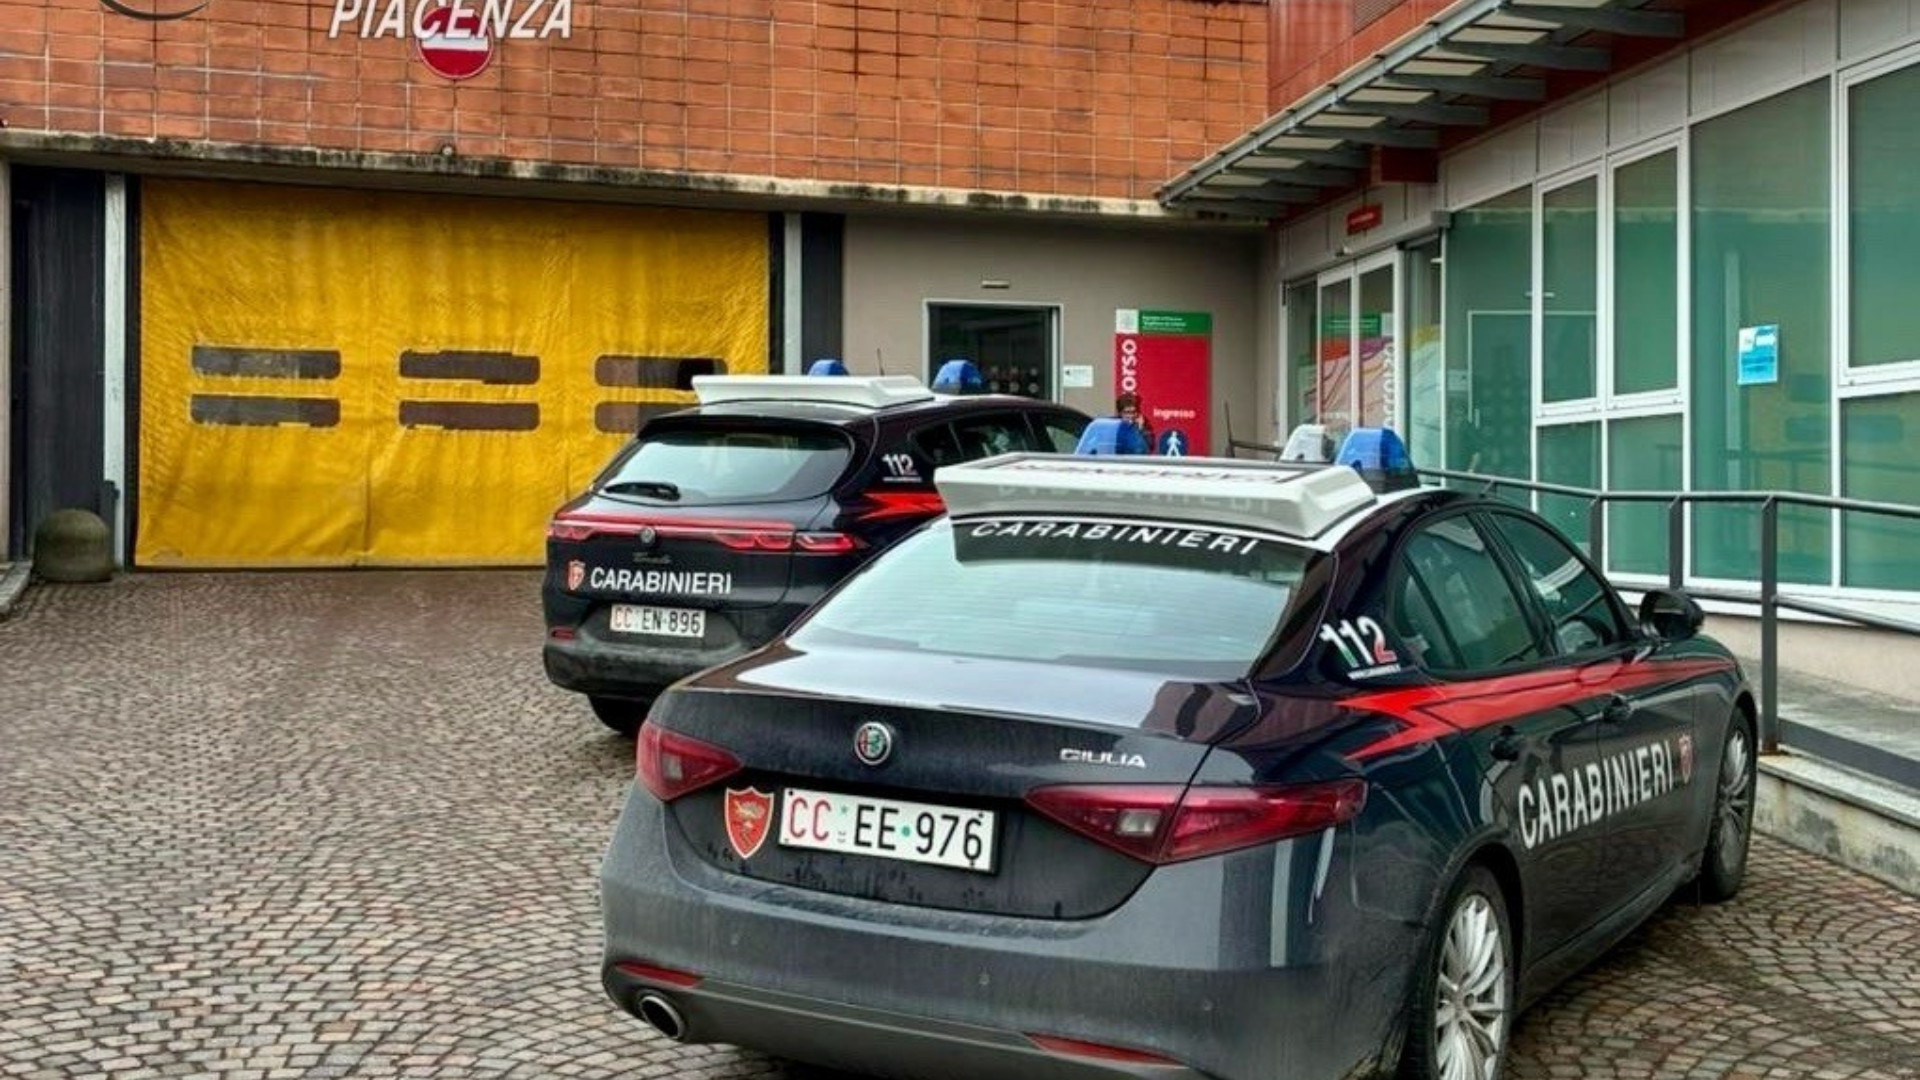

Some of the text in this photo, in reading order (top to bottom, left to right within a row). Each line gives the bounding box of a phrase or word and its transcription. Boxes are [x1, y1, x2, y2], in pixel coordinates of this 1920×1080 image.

[329, 0, 572, 39] PIACENZA
[881, 453, 919, 476] 112
[970, 520, 1261, 556] CARABINIERI
[590, 566, 732, 595] CARABINIERI
[1319, 615, 1398, 669] 112
[1060, 747, 1147, 769] GIULIA
[1518, 740, 1674, 850] CARABINIERI
